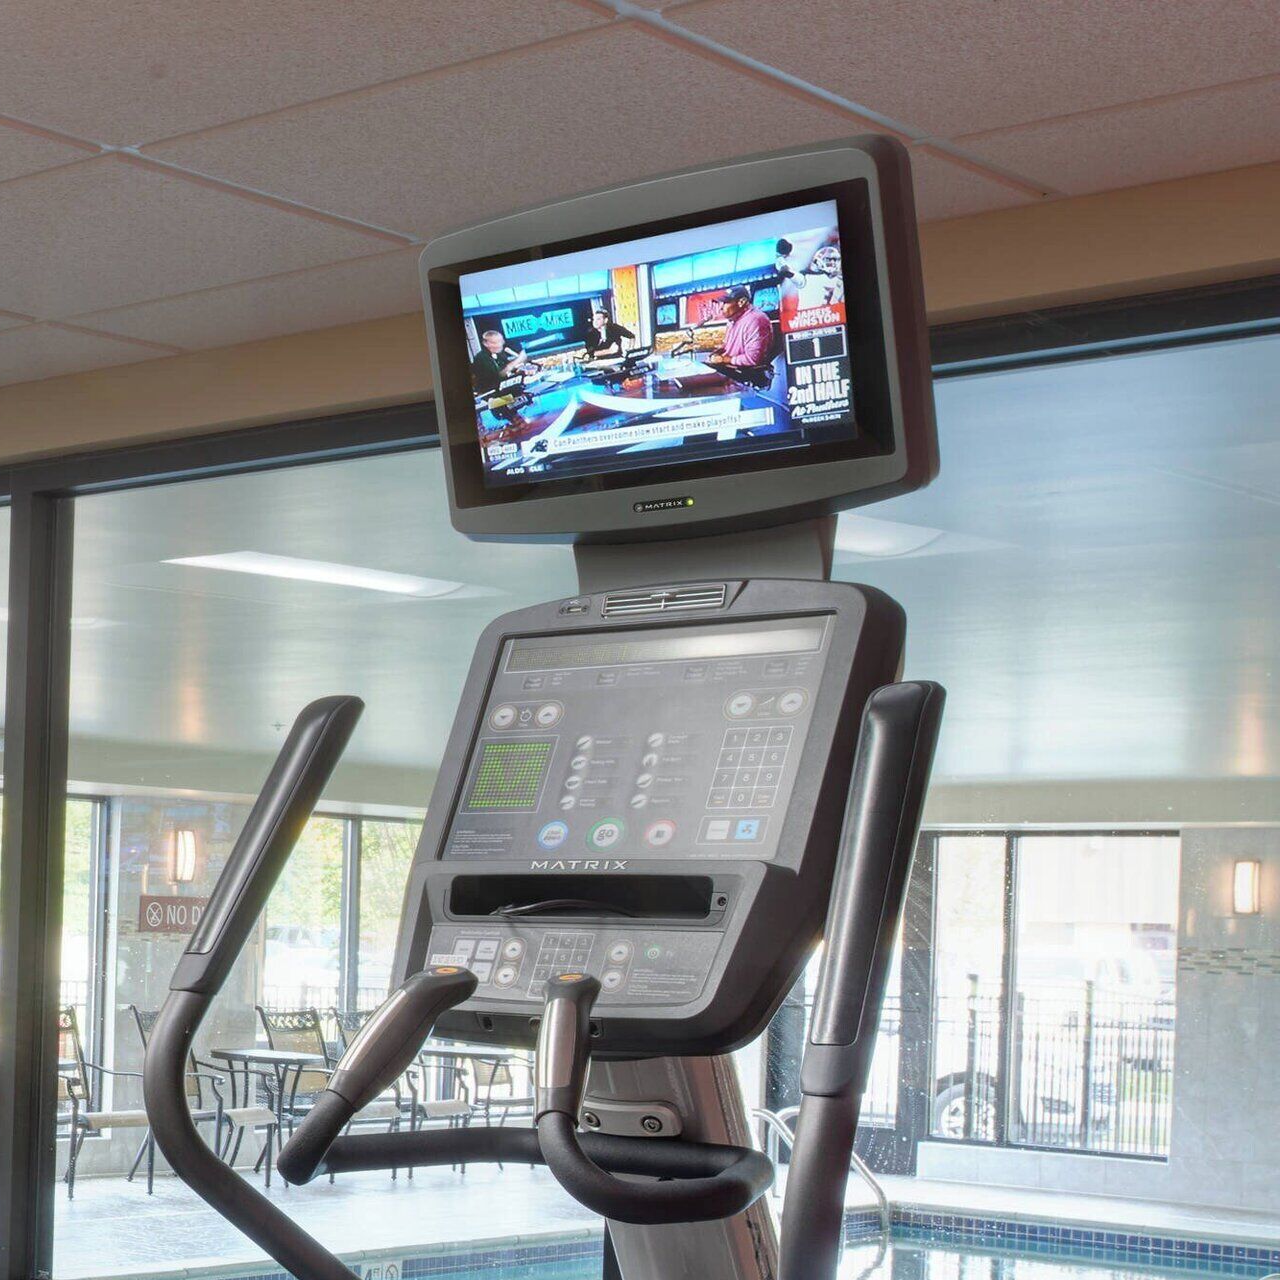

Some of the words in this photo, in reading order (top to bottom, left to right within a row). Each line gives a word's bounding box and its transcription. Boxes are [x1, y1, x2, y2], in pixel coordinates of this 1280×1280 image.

[505, 318, 533, 334] MIKE
[545, 312, 570, 325] MIKE
[788, 312, 840, 329] WINSTON
[812, 338, 820, 358] 1
[795, 365, 813, 385] IN
[812, 361, 841, 382] THE
[788, 384, 814, 405] 2nd
[815, 379, 850, 401] HALF
[567, 436, 599, 446] Panthers
[651, 426, 671, 435] start
[671, 424, 685, 432] and
[686, 421, 706, 430] make
[506, 467, 525, 475] ALDS
[645, 501, 682, 509] MATRIX
[738, 794, 744, 802] 0
[597, 829, 614, 842] go
[530, 860, 629, 870] MATRIX
[166, 905, 187, 925] NO
